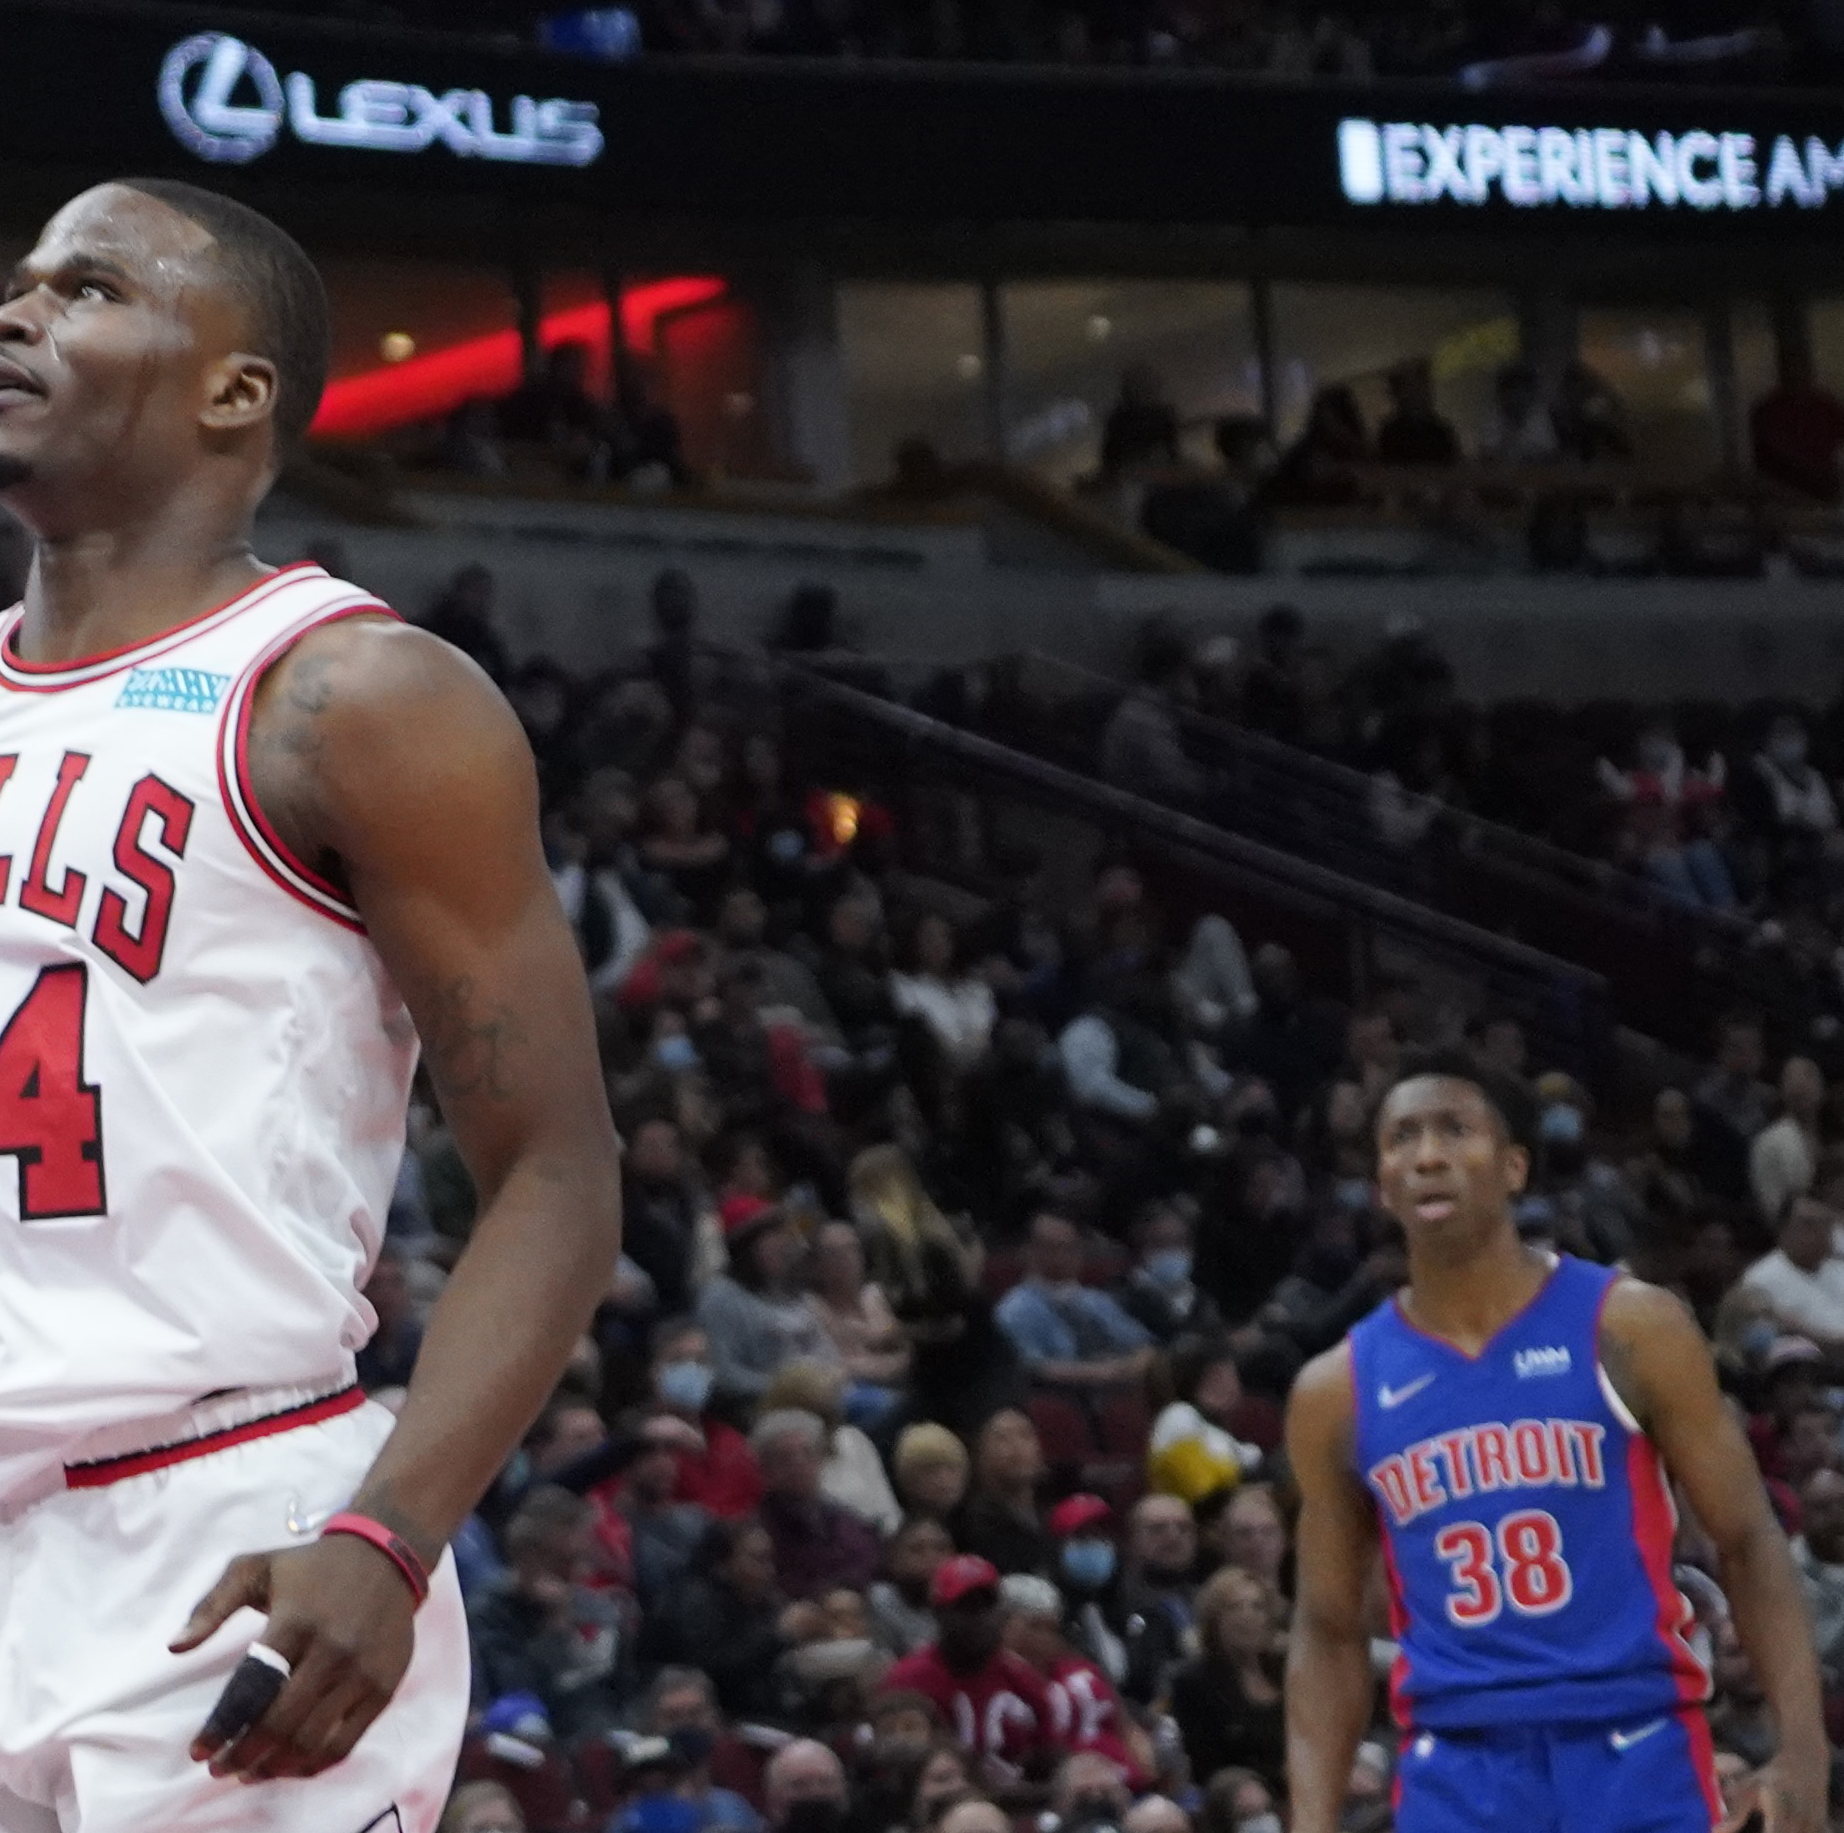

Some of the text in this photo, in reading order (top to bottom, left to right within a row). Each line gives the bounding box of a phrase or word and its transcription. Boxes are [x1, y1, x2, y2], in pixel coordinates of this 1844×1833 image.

[283, 69, 605, 168] LEXUS
[1381, 120, 1761, 212] EXPERIENCE
[1367, 1417, 1605, 1526] DETROIT
[1435, 1507, 1573, 1629] 38
